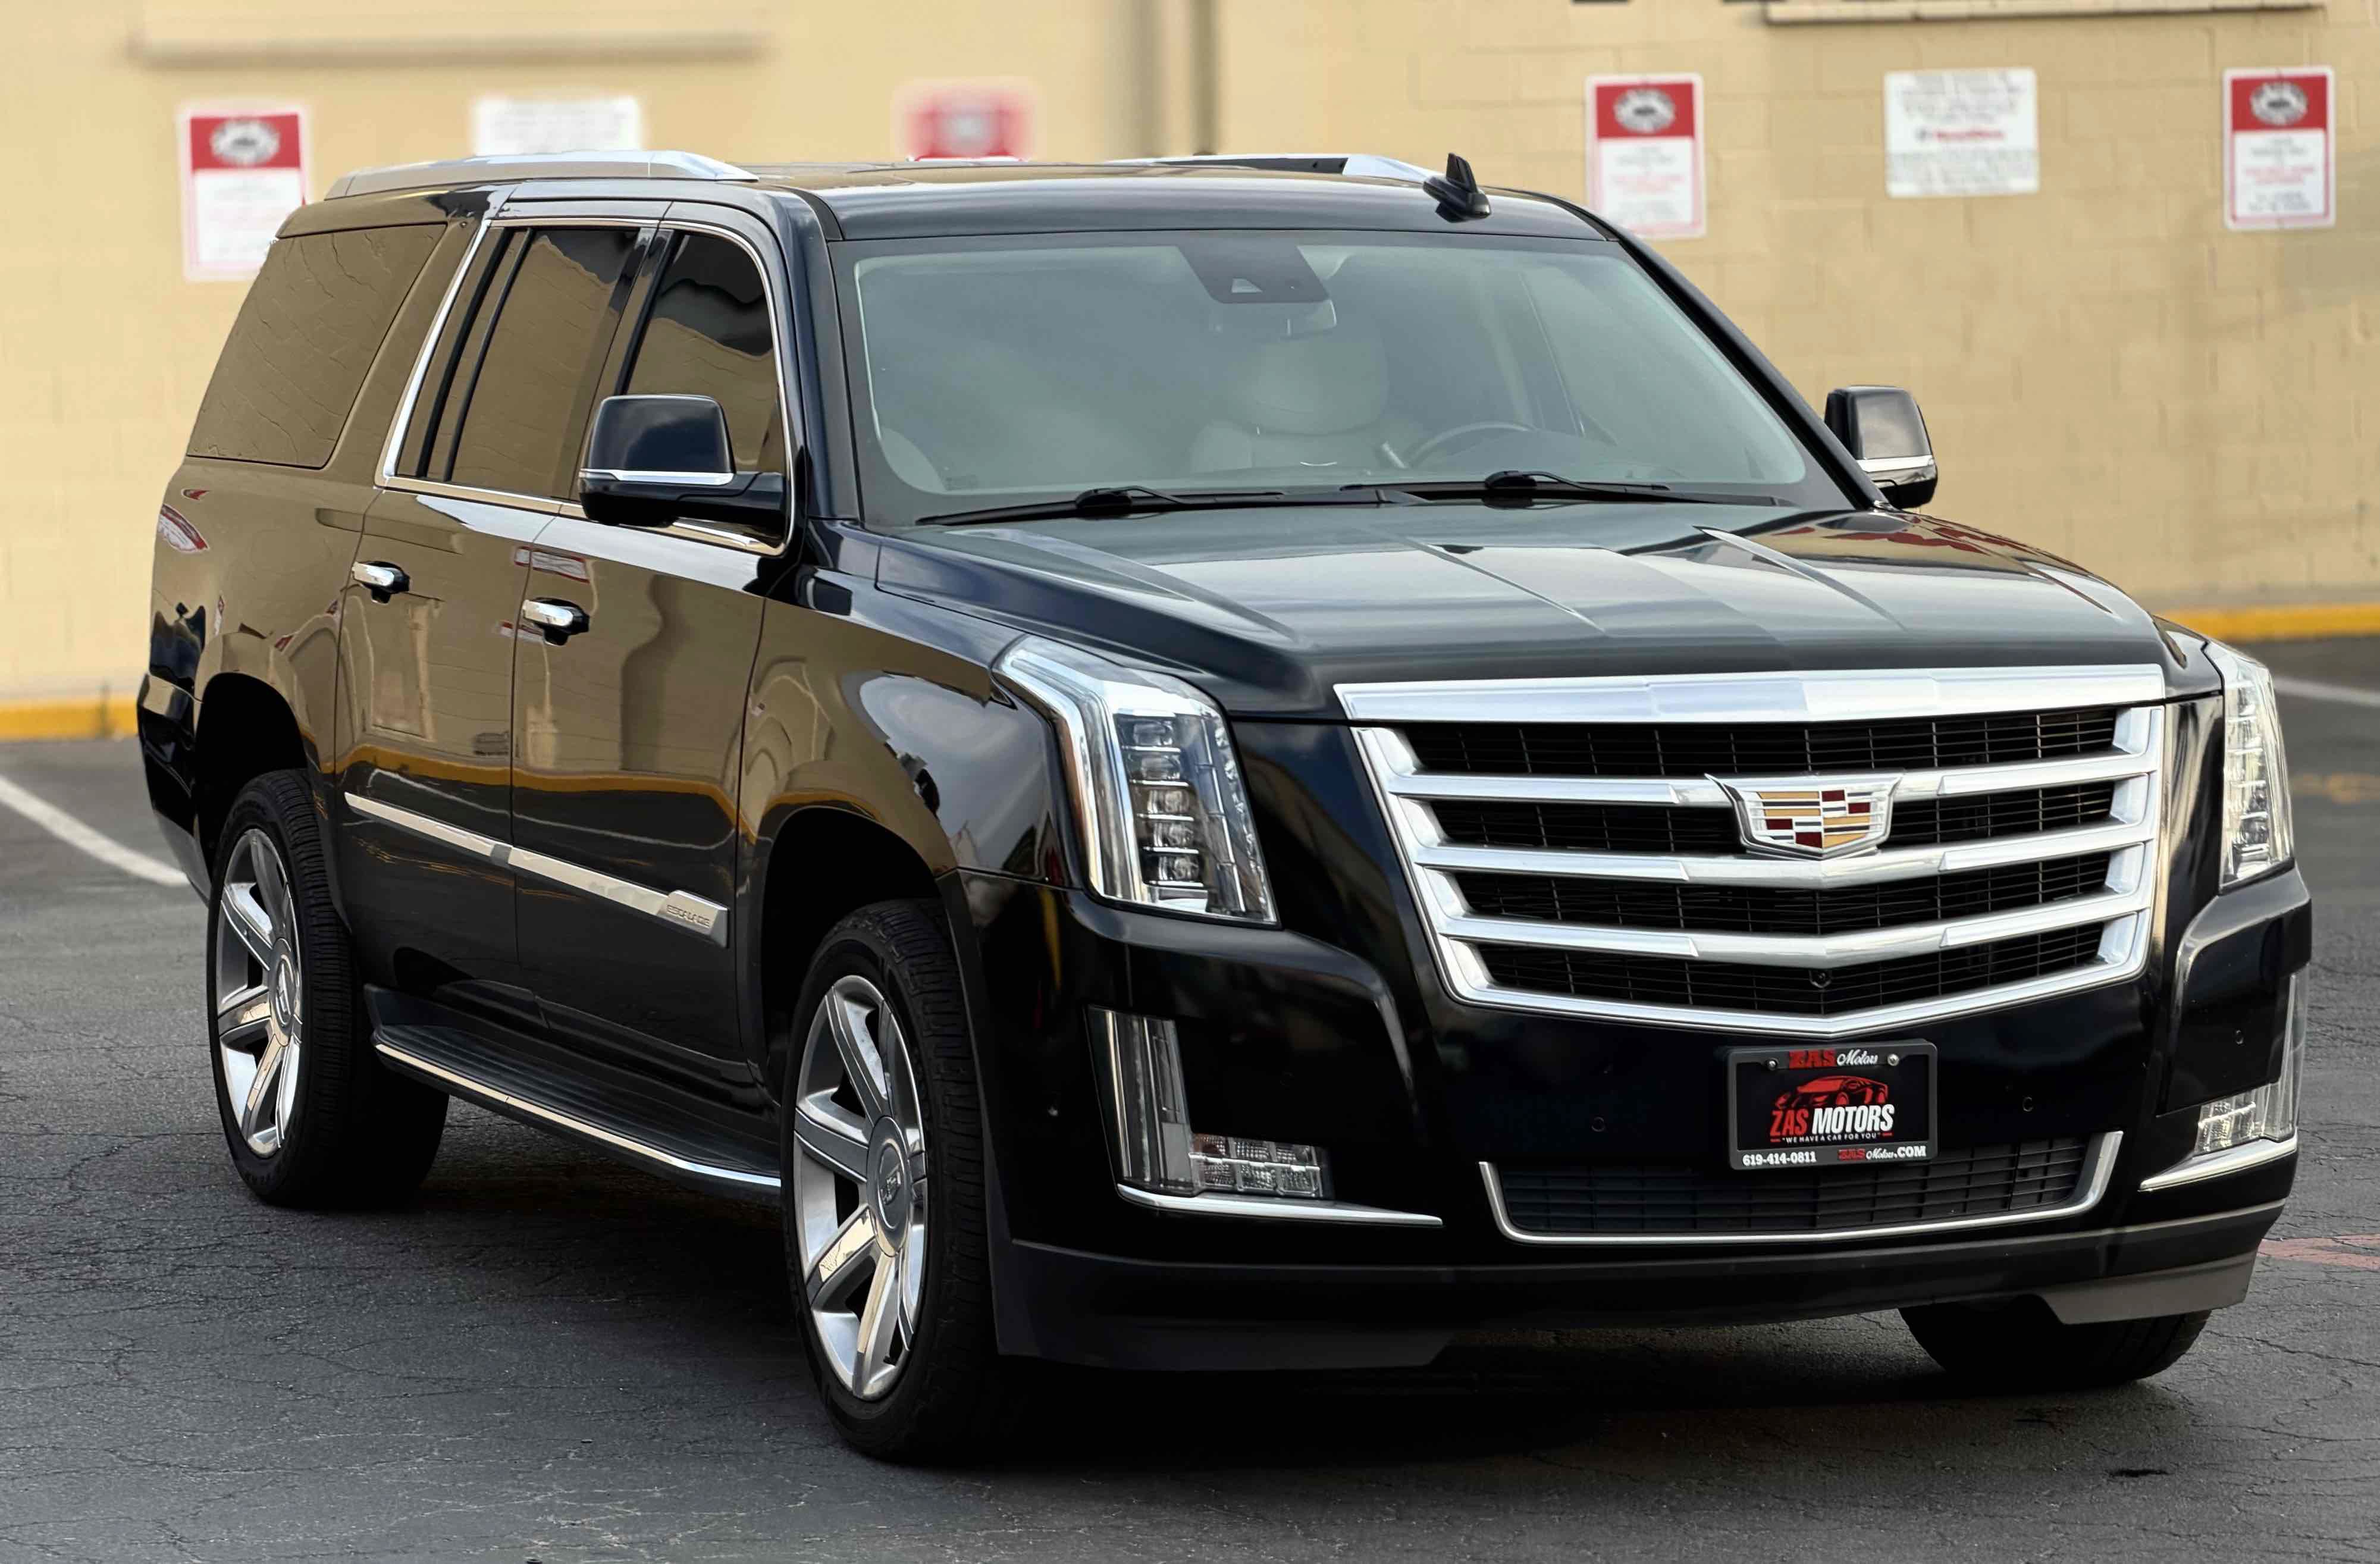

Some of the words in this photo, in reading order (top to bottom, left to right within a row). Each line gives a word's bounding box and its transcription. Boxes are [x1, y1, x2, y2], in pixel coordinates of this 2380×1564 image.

[1789, 1049, 1836, 1068] ZAS
[1770, 1108, 1809, 1137] ZAS
[1812, 1104, 1895, 1134] MOTORS
[1742, 1151, 1816, 1167] 619-414-0811
